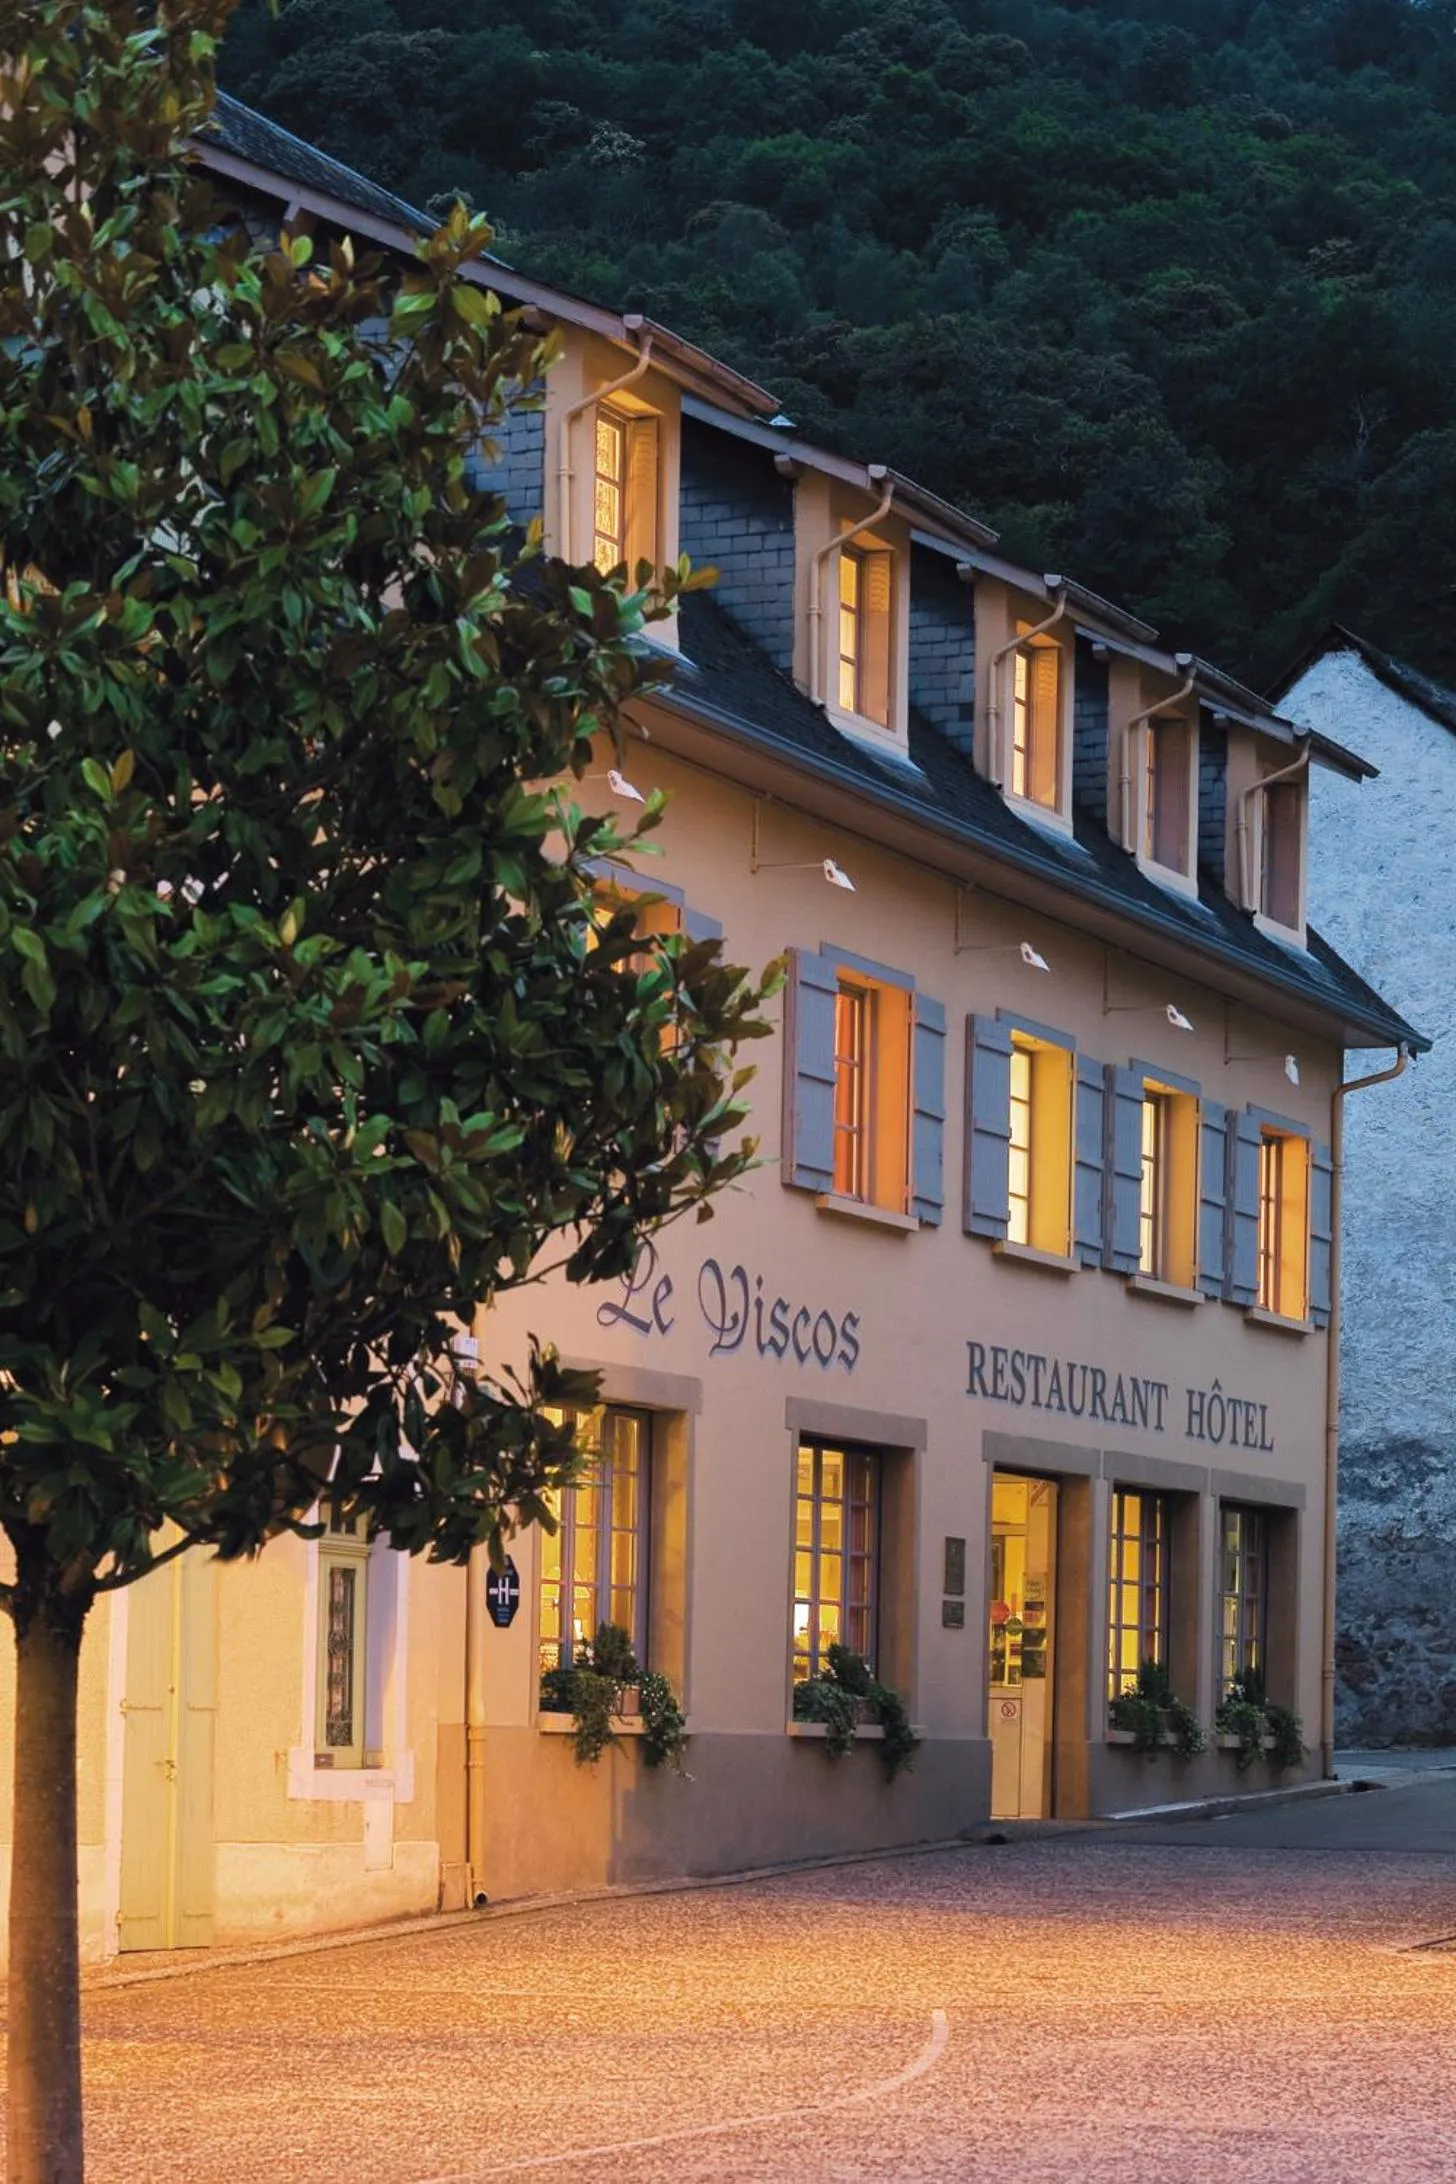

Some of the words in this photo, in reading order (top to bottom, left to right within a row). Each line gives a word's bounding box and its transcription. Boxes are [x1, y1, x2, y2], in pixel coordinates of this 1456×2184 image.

[596, 1238, 675, 1335] Le
[698, 1258, 861, 1371] Viscos
[966, 1341, 1168, 1431] RESTAURANT
[1186, 1378, 1274, 1451] HÔTEL
